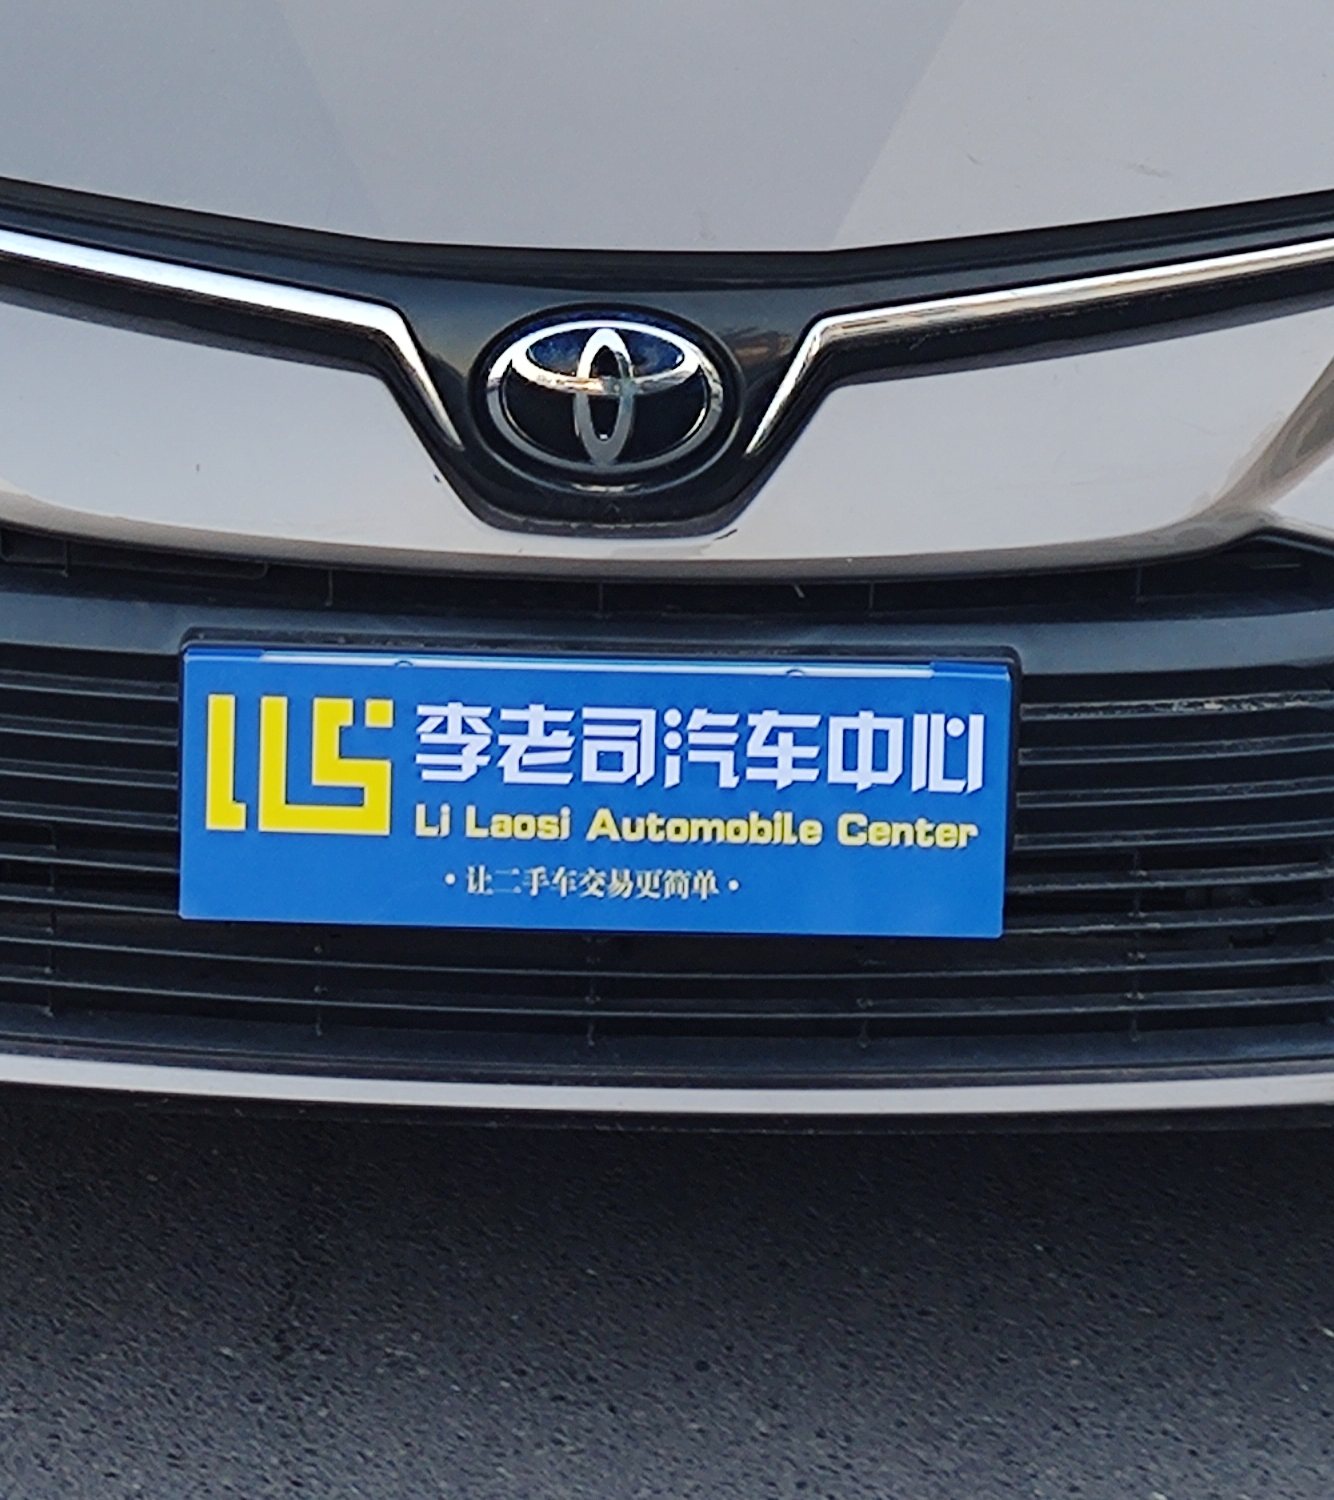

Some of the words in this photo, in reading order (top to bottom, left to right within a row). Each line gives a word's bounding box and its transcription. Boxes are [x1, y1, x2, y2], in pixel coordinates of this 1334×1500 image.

[414, 701, 986, 794] 李老司汽车中心
[414, 802, 451, 838] Li
[464, 805, 571, 842] Laosi
[585, 807, 824, 846] Automobile
[836, 811, 980, 850] Center
[465, 864, 721, 902] 让二手车交易更简单
